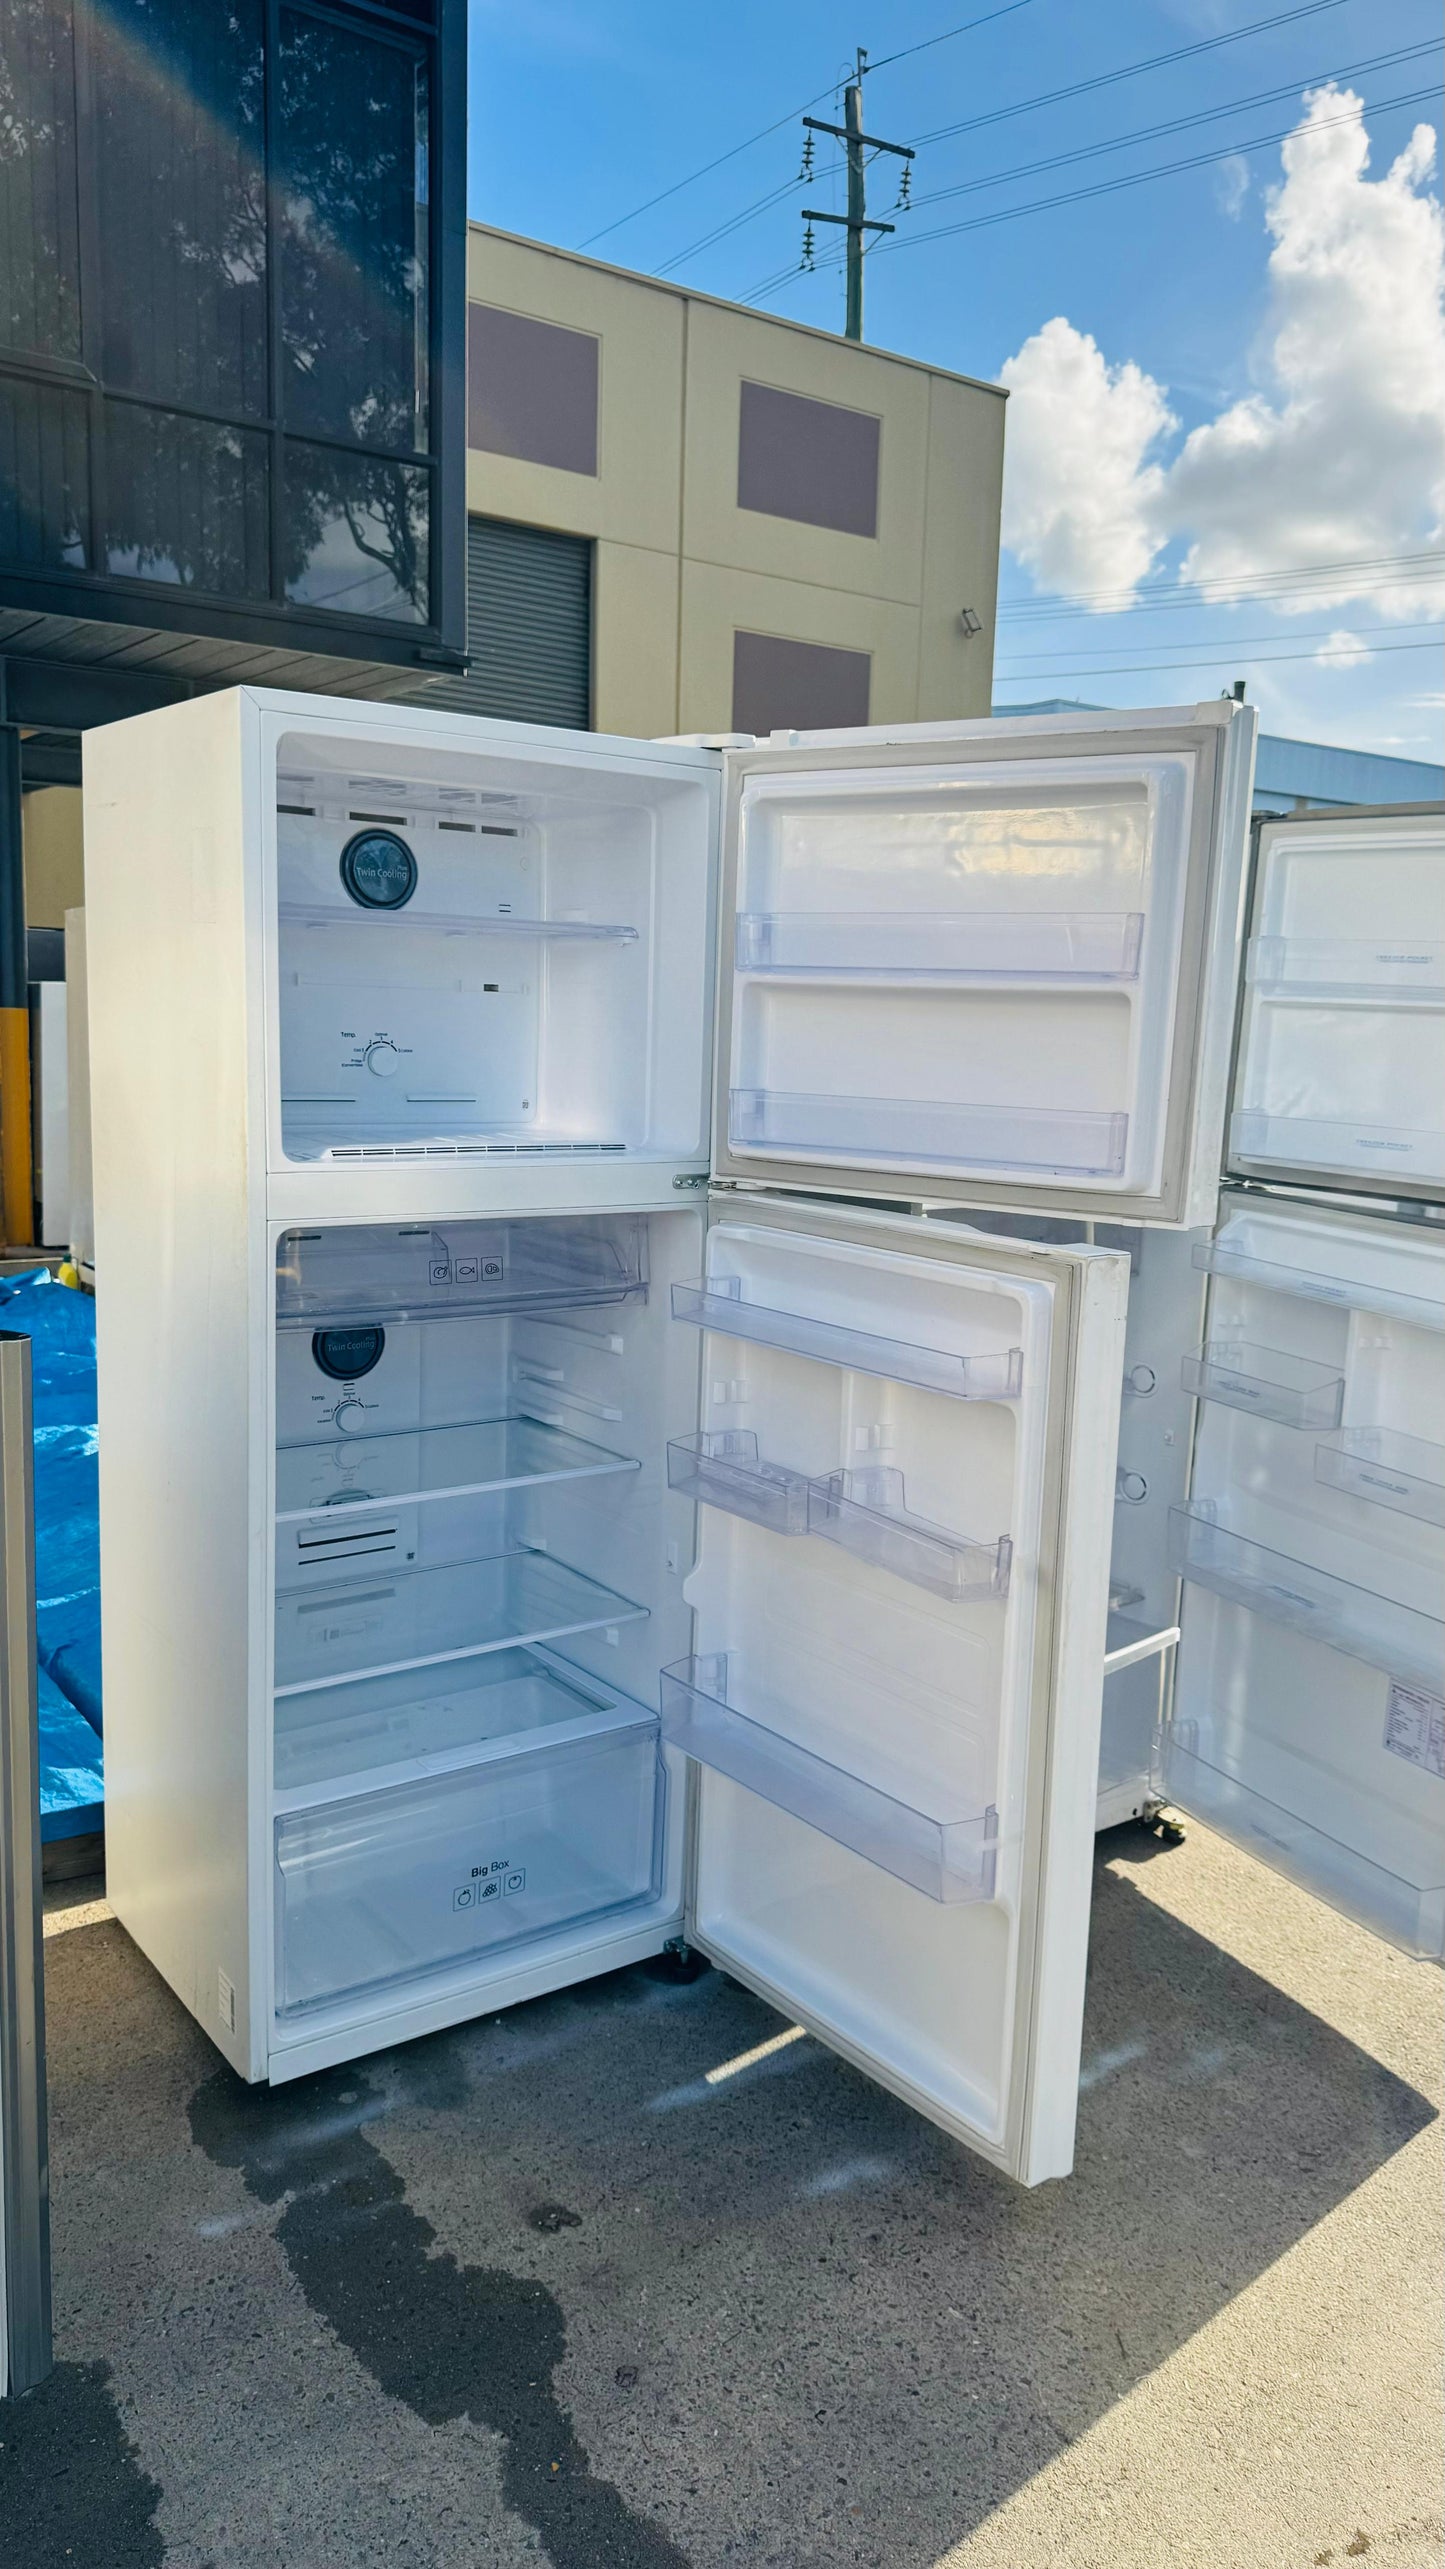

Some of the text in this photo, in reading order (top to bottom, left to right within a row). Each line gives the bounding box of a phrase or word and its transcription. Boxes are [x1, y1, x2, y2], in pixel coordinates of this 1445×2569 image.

[356, 867, 408, 881] Twin Cooling
[328, 1340, 375, 1352] Twin Cooling
[471, 1860, 510, 1878] Big Box
